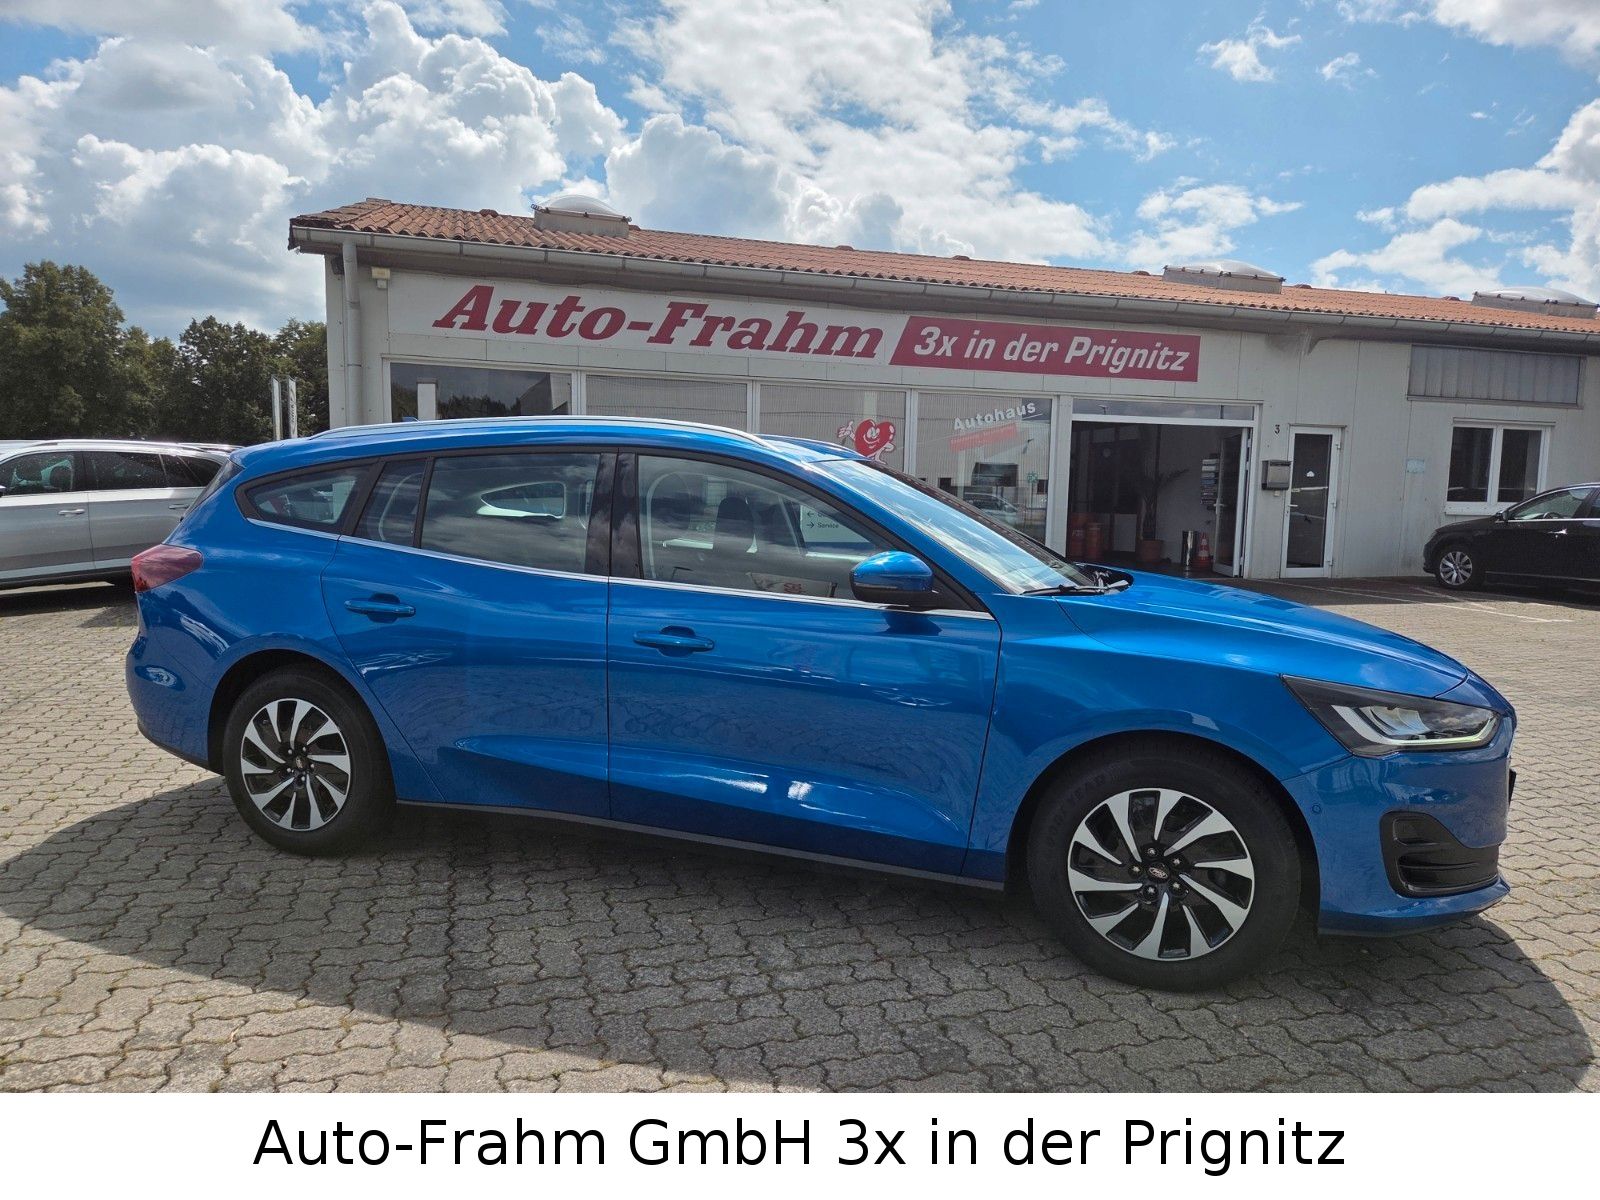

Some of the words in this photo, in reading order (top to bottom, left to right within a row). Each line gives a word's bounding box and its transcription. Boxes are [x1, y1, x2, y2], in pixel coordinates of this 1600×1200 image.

[432, 285, 883, 358] Auto-Frahm
[914, 326, 958, 356] 3x
[964, 329, 996, 359] in
[1003, 333, 1058, 363] der
[1064, 336, 1190, 373] Prignitz
[953, 401, 1036, 430] Autohaus
[1274, 424, 1281, 435] 3
